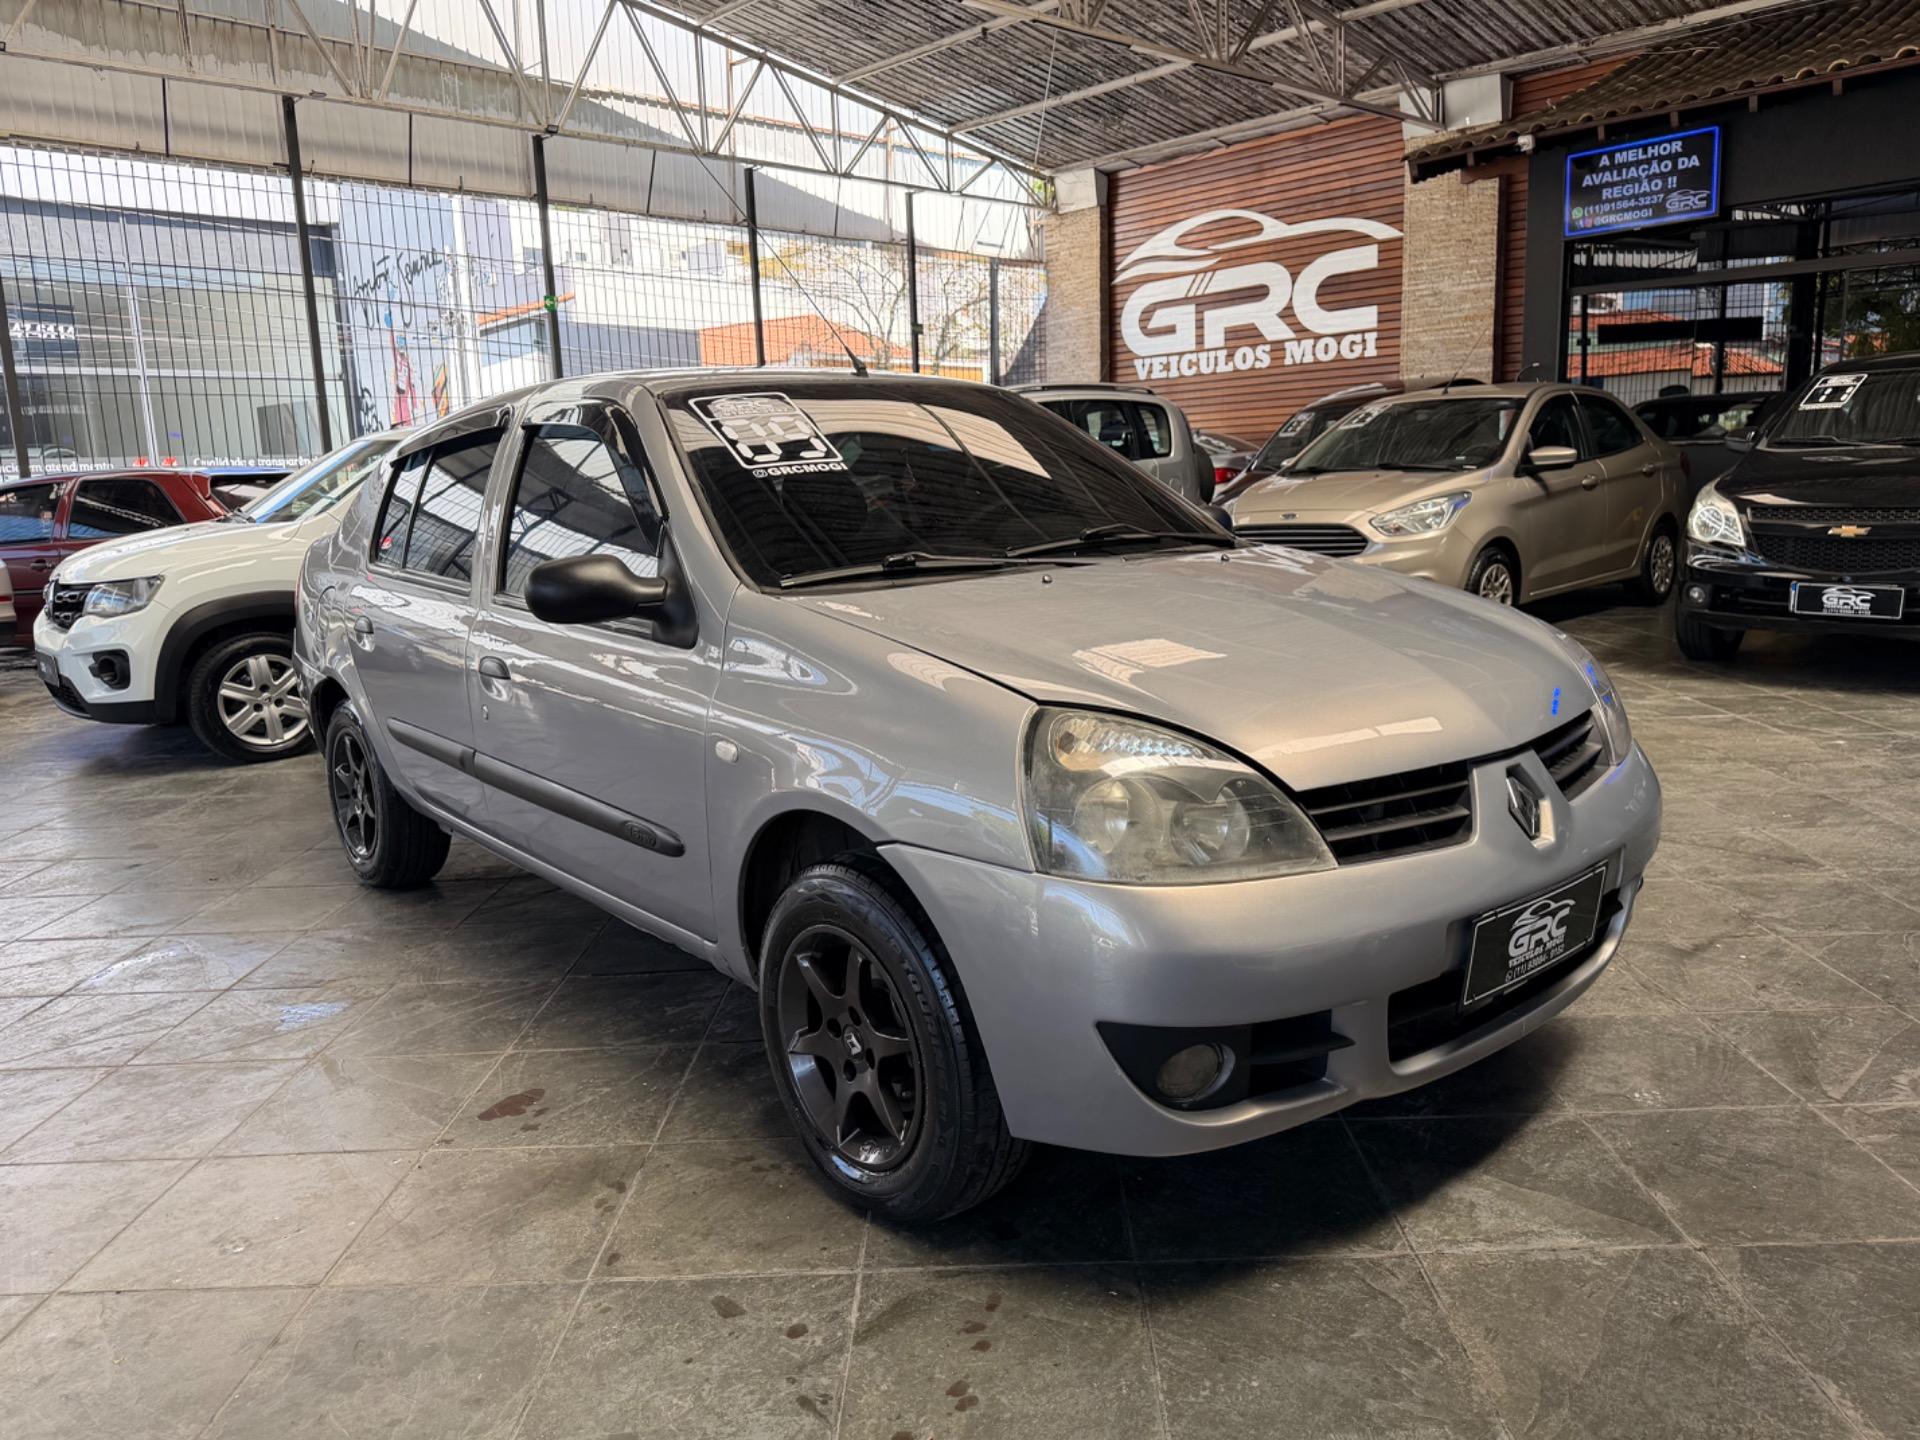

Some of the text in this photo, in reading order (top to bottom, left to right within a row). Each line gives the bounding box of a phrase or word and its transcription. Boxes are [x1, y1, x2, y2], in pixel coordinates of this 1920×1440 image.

[1599, 140, 1682, 167] A MELHOR
[1582, 155, 1700, 188] AVALIAÇÃO DA
[1602, 176, 1678, 200] REGIÃO !!
[1120, 243, 1378, 357] GRC
[1133, 332, 1378, 380] VEICULOS MOGI
[752, 462, 849, 478] @GRCMOGI
[1821, 594, 1872, 607] GRC
[1508, 907, 1571, 957] GRC
